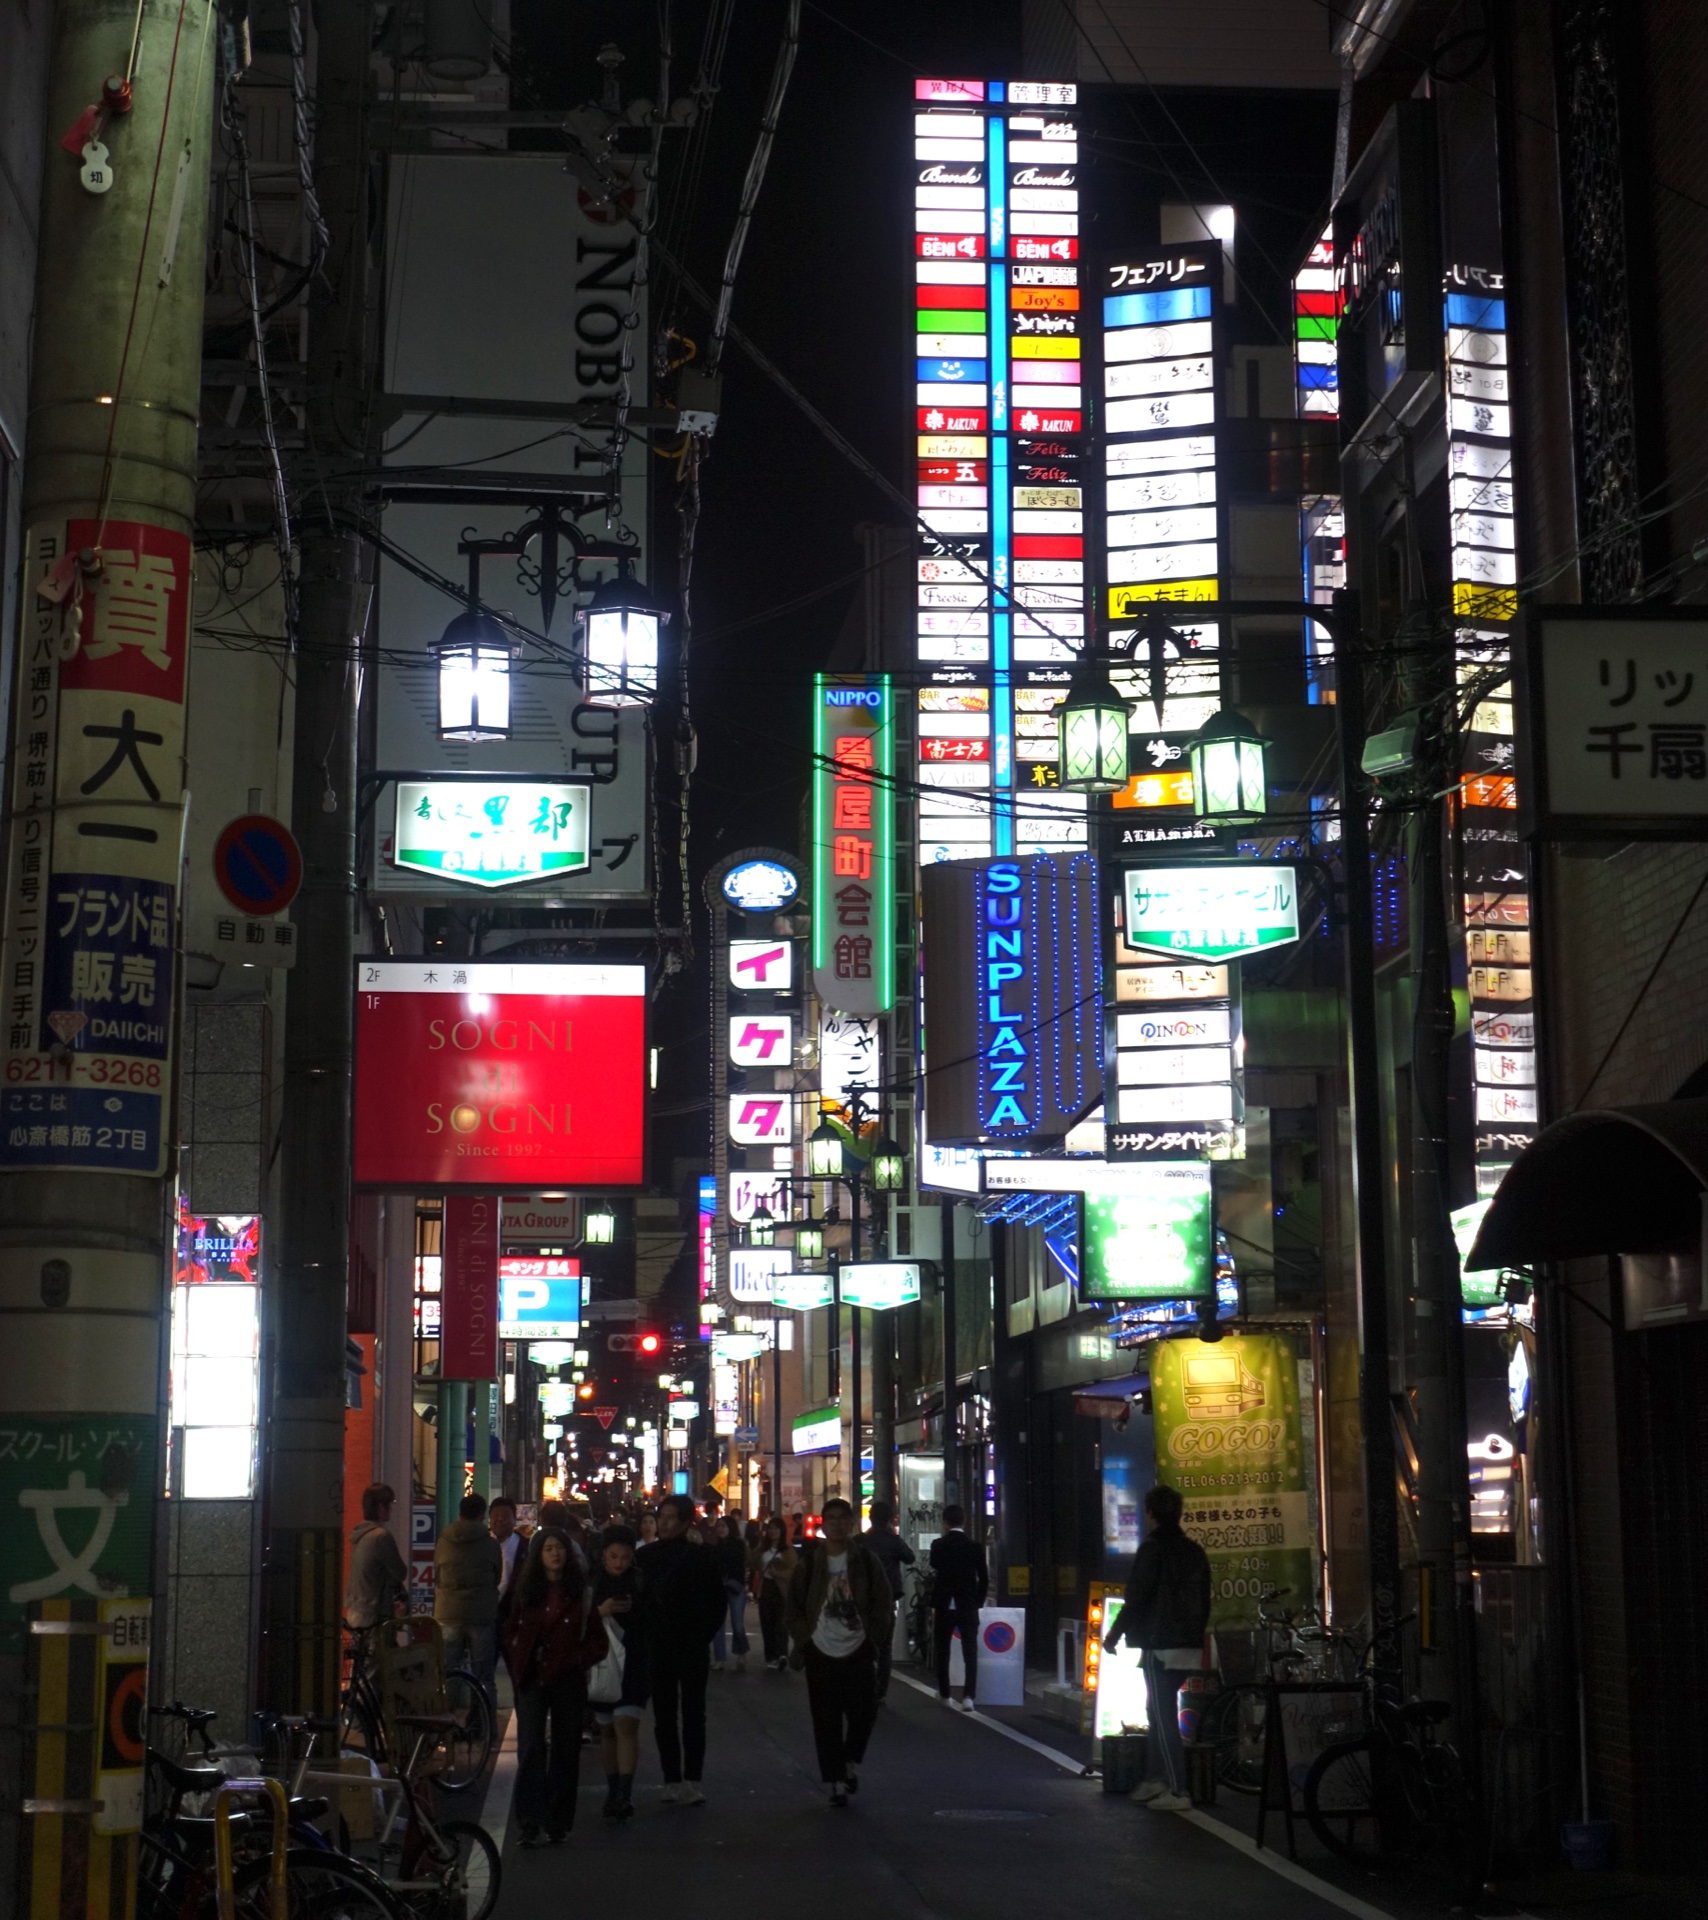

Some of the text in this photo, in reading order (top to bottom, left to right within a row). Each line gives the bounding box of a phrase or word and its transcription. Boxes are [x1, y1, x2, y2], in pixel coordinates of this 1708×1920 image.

[1014, 85, 1073, 103] 管理室
[922, 242, 956, 257] BENI
[1016, 244, 1049, 259] BENI
[1109, 258, 1205, 288] フェアリー
[1024, 294, 1065, 310] Joy's
[992, 380, 1006, 419] 4F
[946, 417, 980, 431] RAKUN
[1041, 419, 1074, 432] RAKUN
[1025, 442, 1068, 456] Feliz
[954, 462, 979, 482] 五
[1025, 467, 1068, 481] Feliz
[82, 548, 177, 672] 質
[923, 617, 982, 631] モカラ
[824, 690, 882, 707] NIPPO
[919, 690, 941, 699] BAR
[1016, 690, 1037, 700] BAR
[1016, 716, 1037, 725] BAR
[995, 733, 1010, 775] 2F
[833, 736, 873, 981] 畳屋町会館
[57, 888, 170, 949] ブランド品
[218, 920, 293, 946] 自動車
[70, 951, 156, 1008] 販売
[366, 967, 381, 983] 2F
[423, 969, 468, 985] 木渦
[366, 995, 380, 1010] 1F
[985, 862, 1031, 1127] SUNPLAZA
[91, 1017, 164, 1045] DAIICHI
[428, 1019, 573, 1050] SOGNI
[736, 946, 786, 1137] イケダ
[6, 1056, 162, 1088] 6211-3268
[482, 1062, 519, 1093] di
[9, 1094, 67, 1112] ここは
[426, 1102, 572, 1135] SOGNI
[456, 1142, 543, 1157] Since 1997
[524, 1212, 569, 1229] GROUP
[194, 1238, 254, 1250] BRILLIA
[211, 1251, 237, 1259] BAR
[546, 1260, 570, 1276] 24
[503, 1279, 550, 1321] P
[470, 1283, 486, 1356] SOGNI
[1173, 1422, 1283, 1453] GOGO!
[1176, 1471, 1285, 1488] TEL.06-6213-2012
[1183, 1506, 1282, 1523] お客様も女の子も
